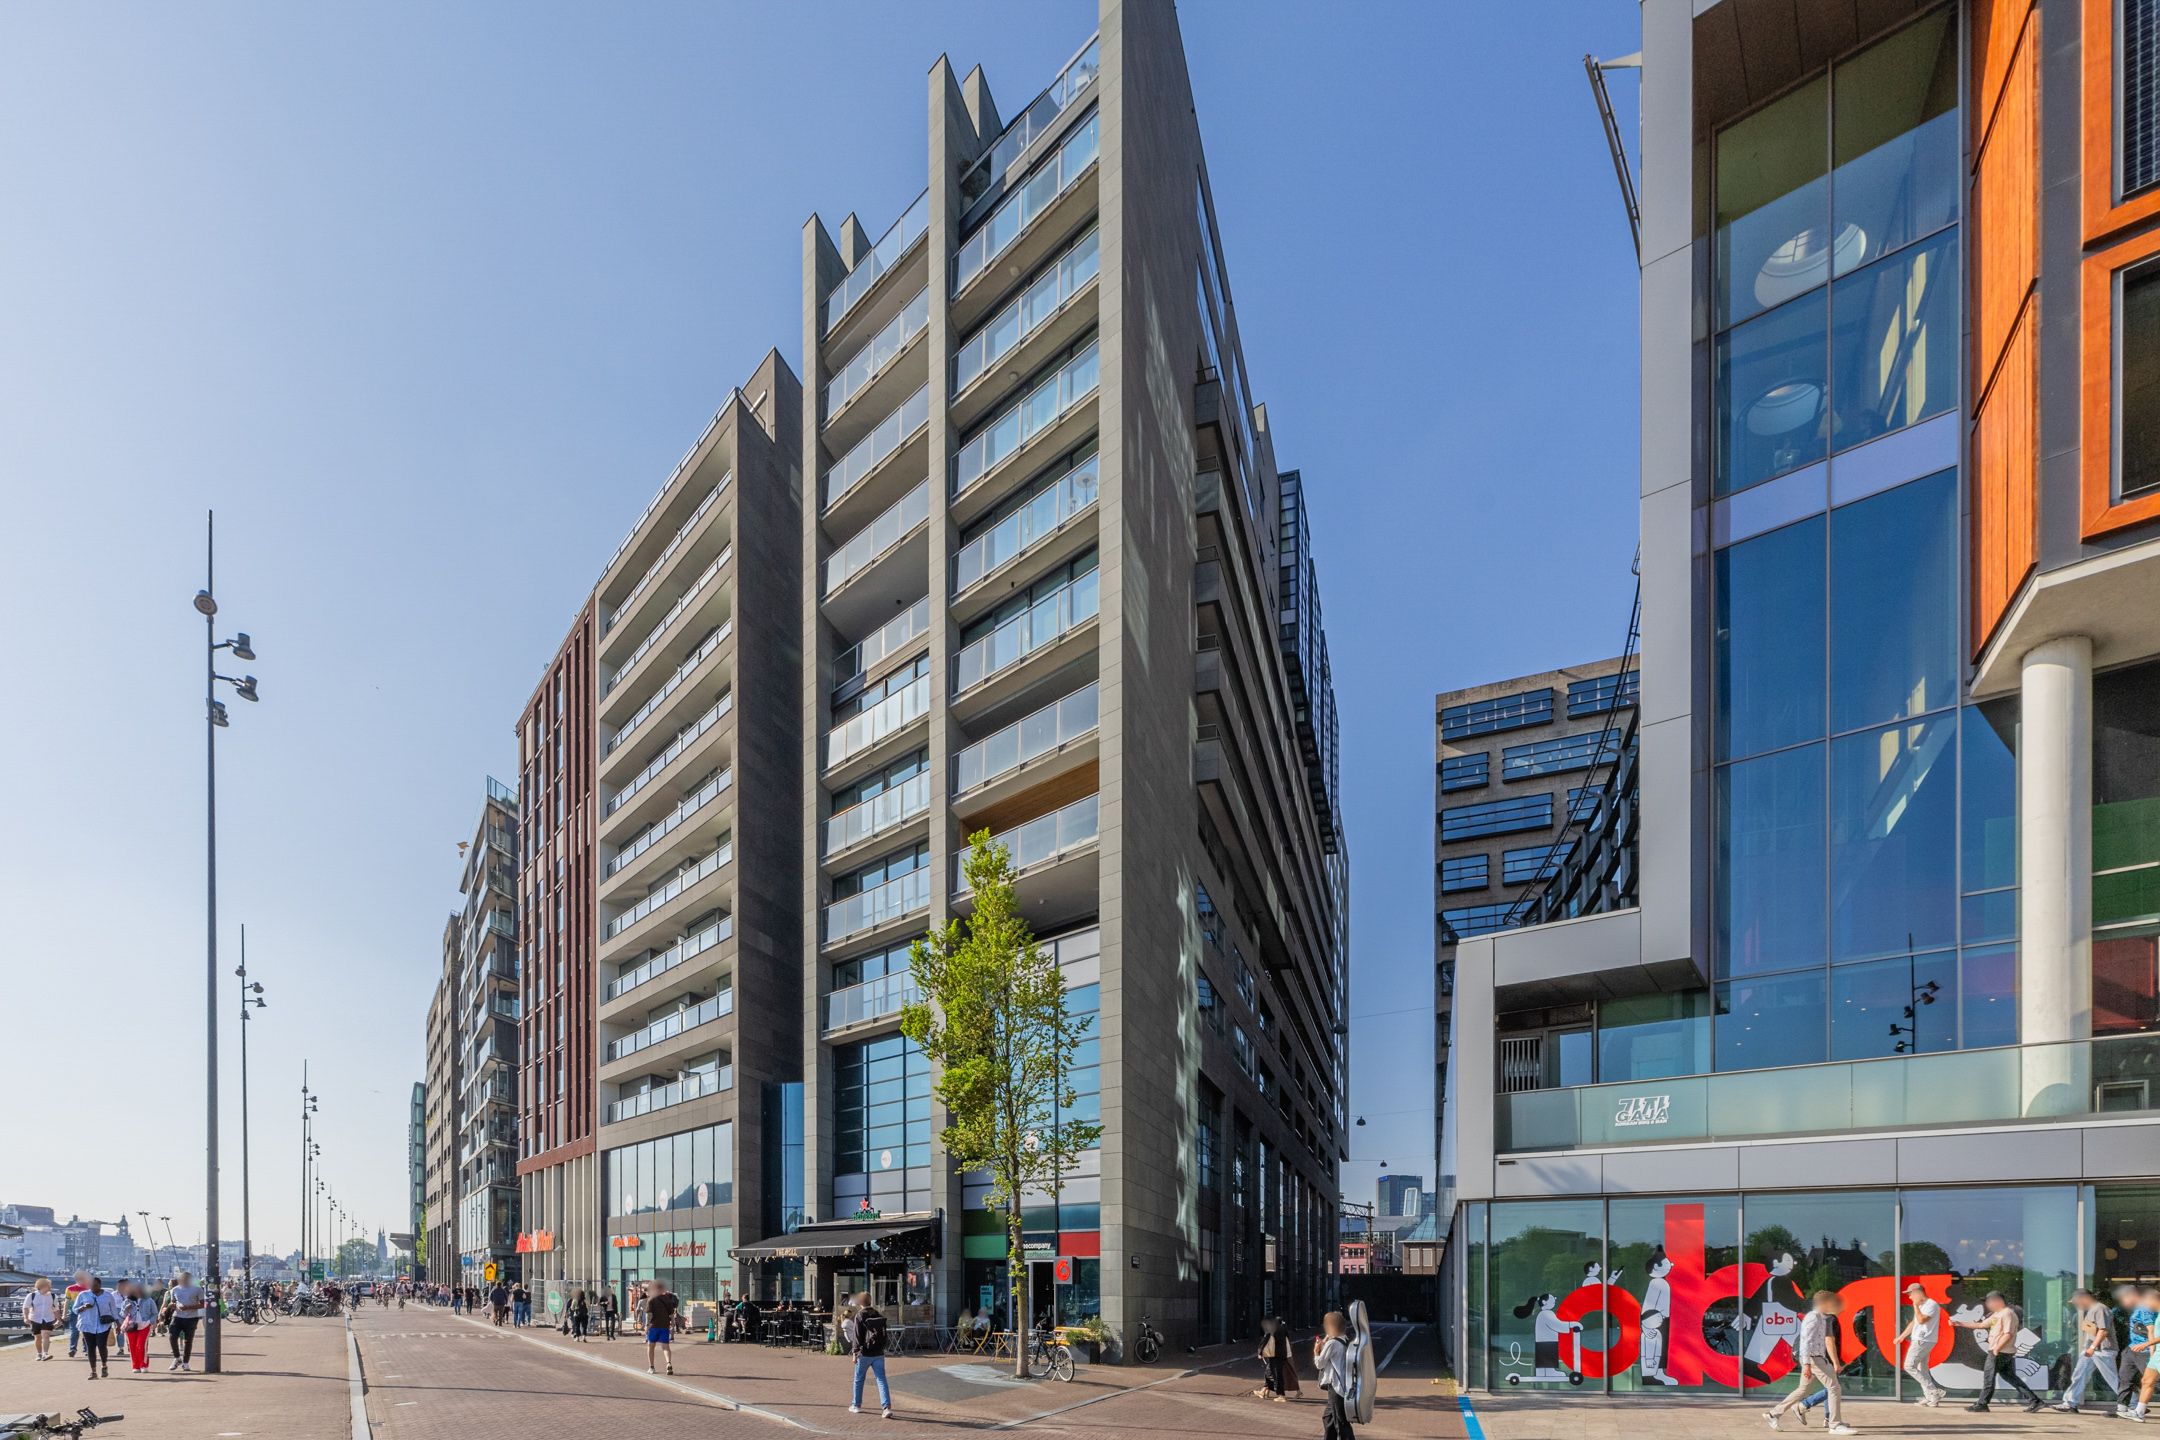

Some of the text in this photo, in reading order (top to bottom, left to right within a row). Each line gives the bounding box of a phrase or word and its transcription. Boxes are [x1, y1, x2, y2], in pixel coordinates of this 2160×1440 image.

[1615, 1107, 1669, 1123] GAJA
[662, 1241, 706, 1257] Media Markt
